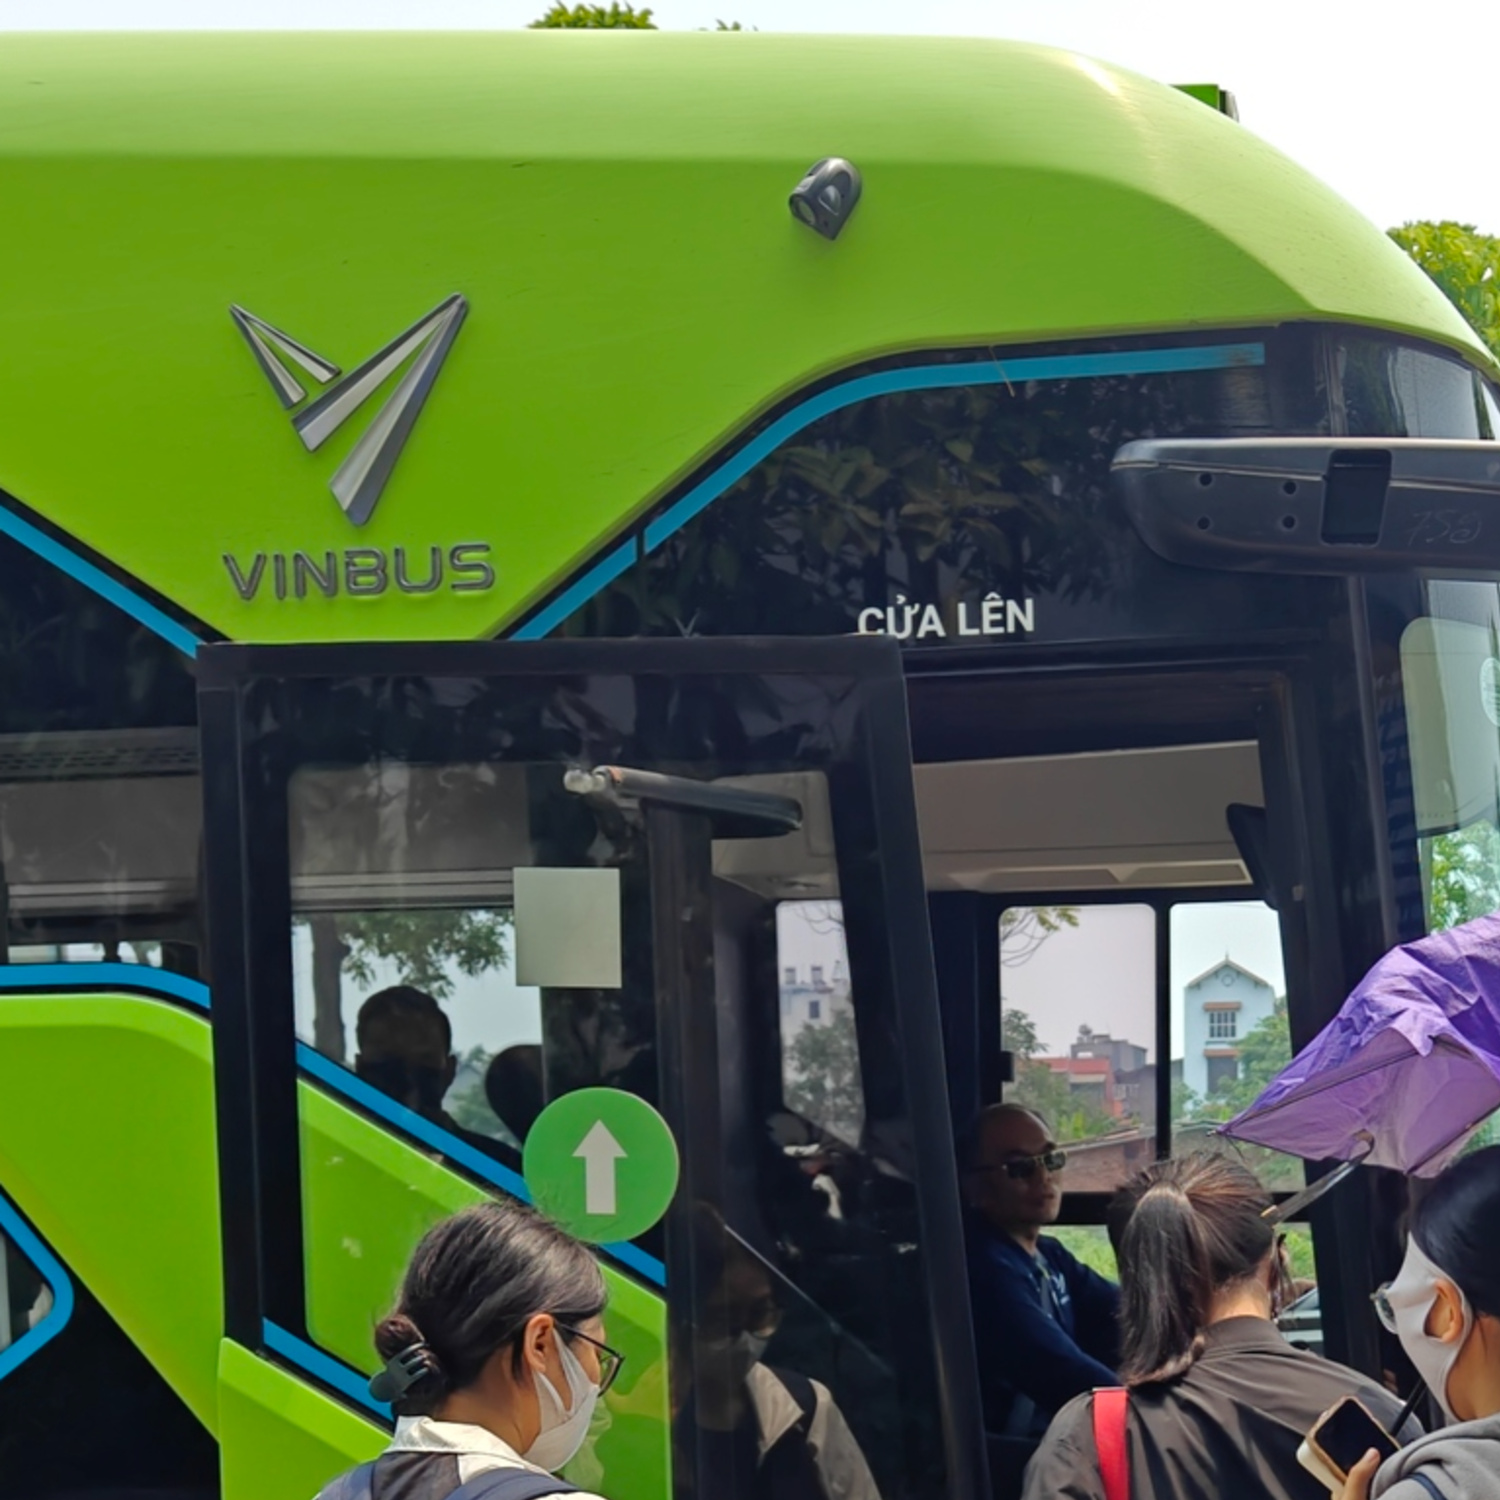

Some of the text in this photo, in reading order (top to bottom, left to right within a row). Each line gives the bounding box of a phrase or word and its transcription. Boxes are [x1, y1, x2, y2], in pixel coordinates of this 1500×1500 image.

[223, 543, 494, 600] VINBUS
[858, 592, 1034, 639] CỬA LÊN
